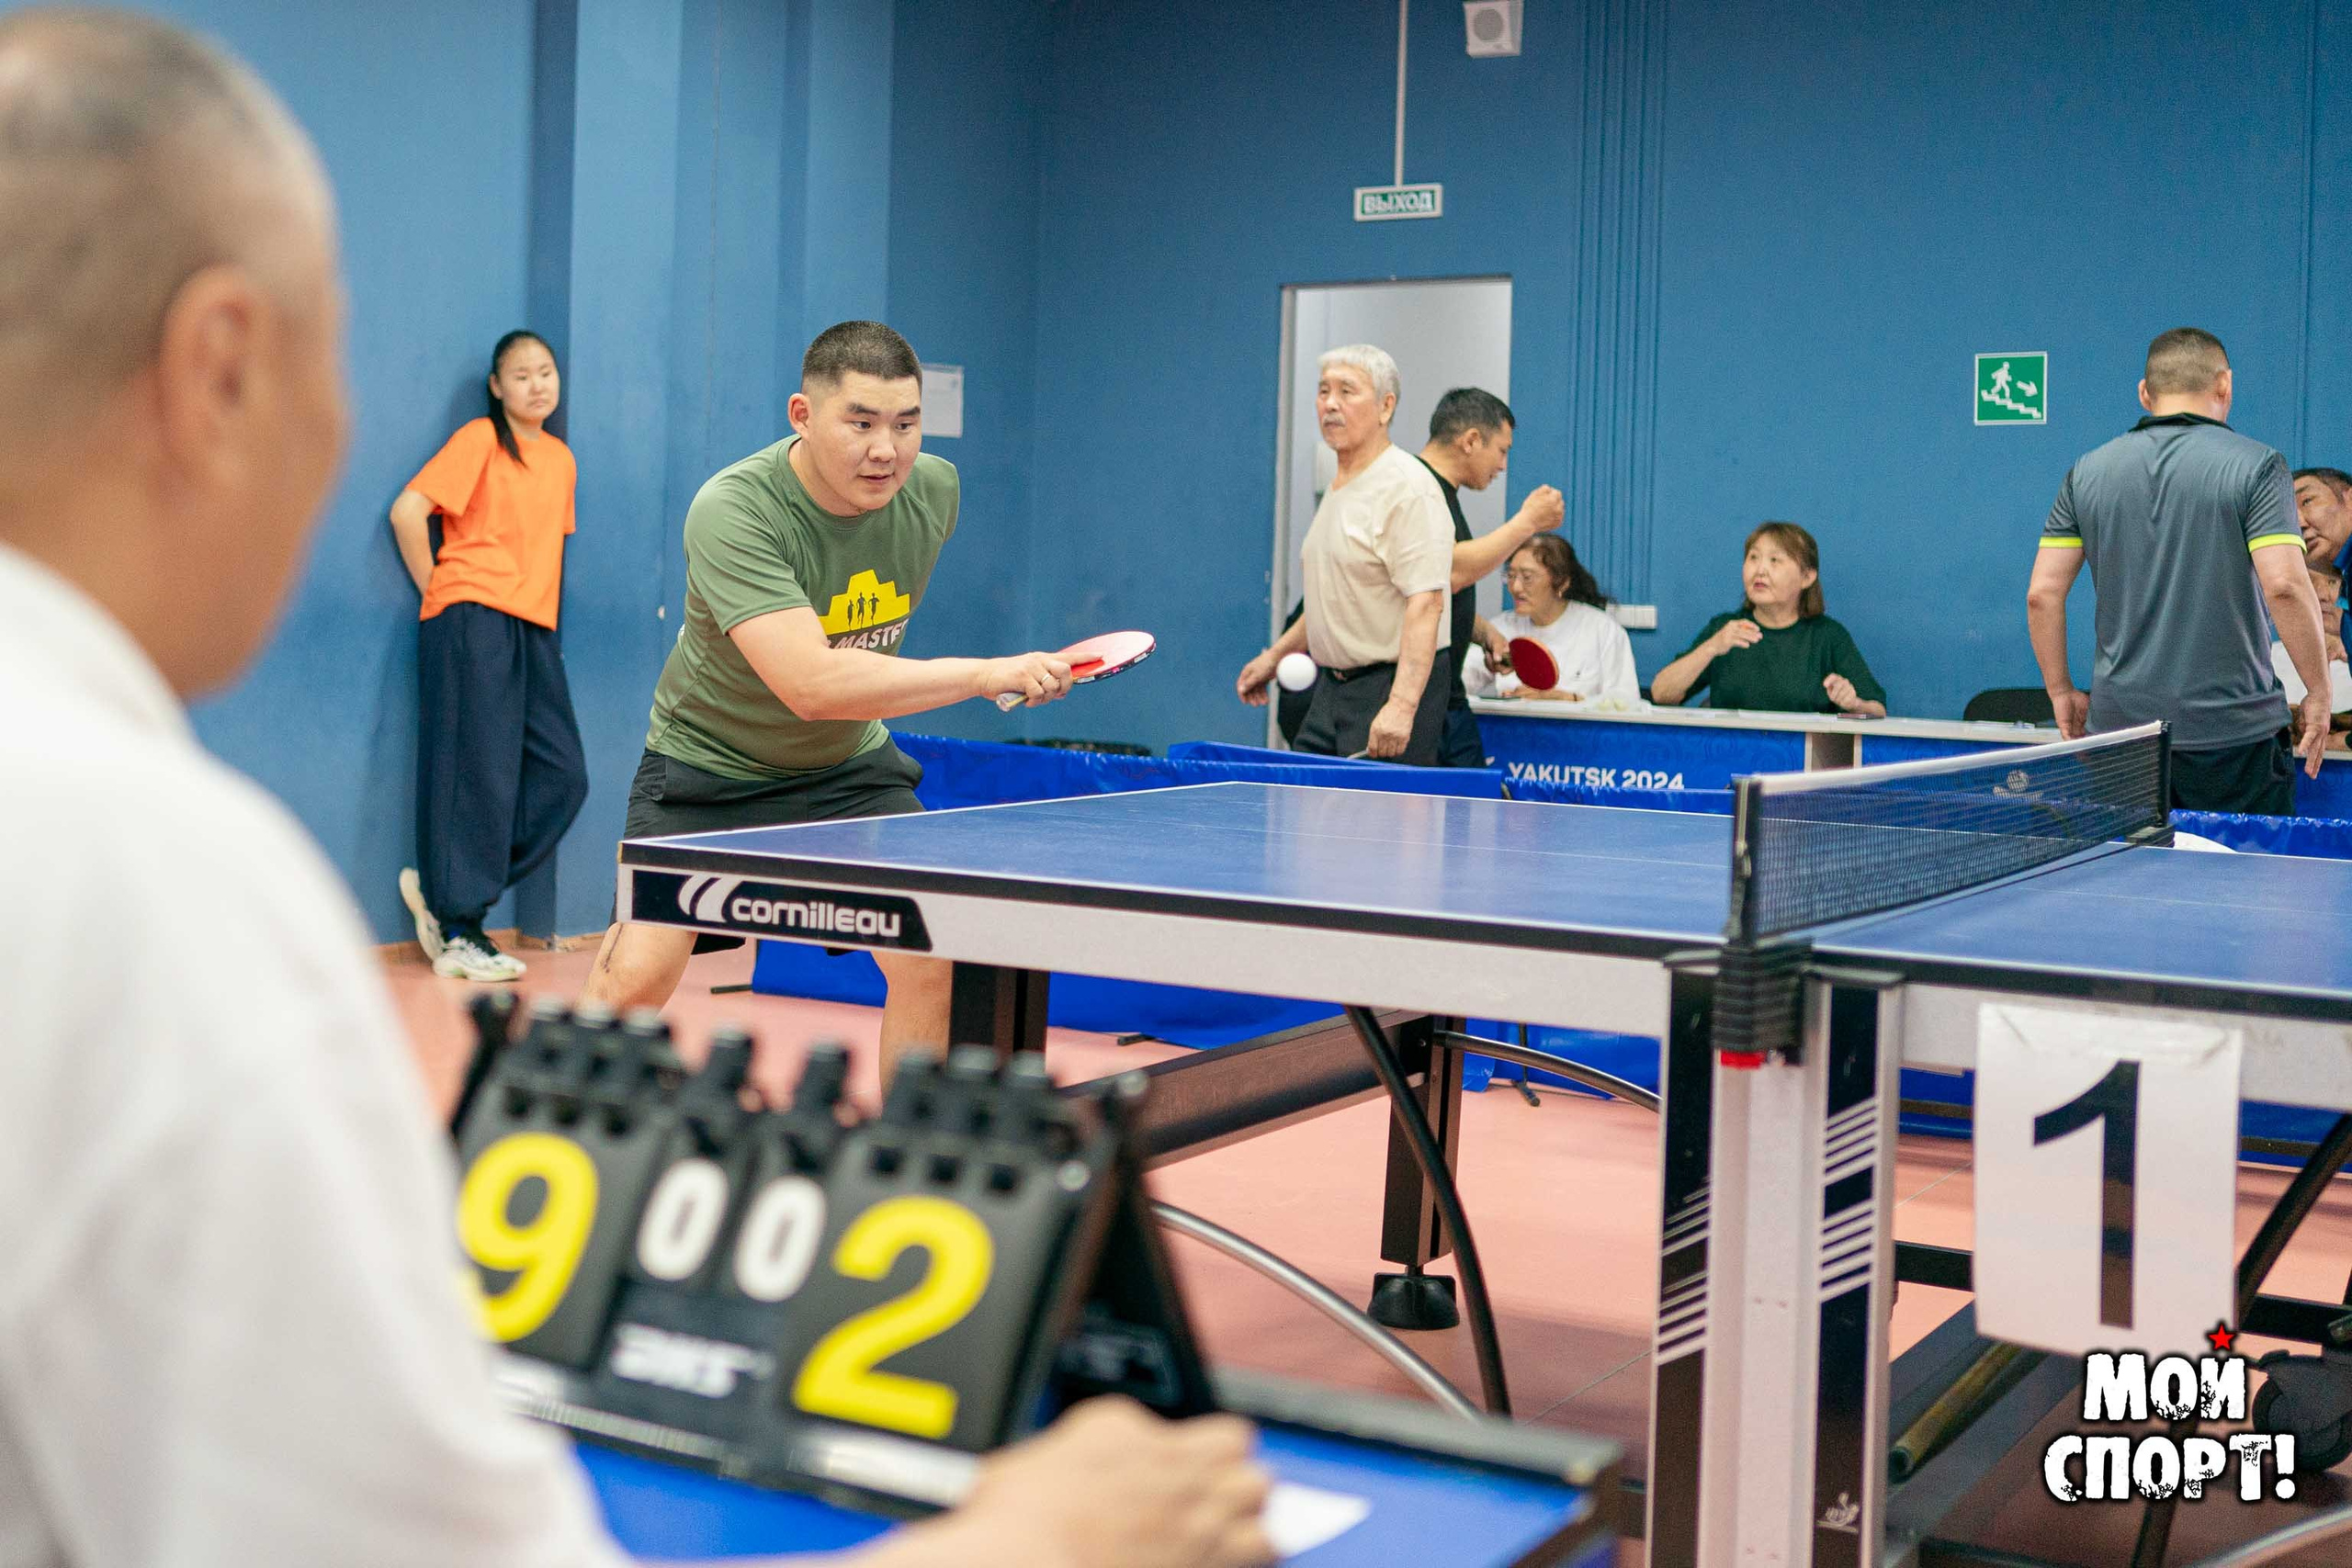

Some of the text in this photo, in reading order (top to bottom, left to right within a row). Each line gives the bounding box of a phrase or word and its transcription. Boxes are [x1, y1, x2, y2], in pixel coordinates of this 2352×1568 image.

[1364, 193, 1432, 213] ВЫХОД
[1508, 761, 1684, 790] YAKUTSK 2024
[731, 897, 901, 938] cornilleau
[2032, 1059, 2142, 1330] 1
[459, 1133, 599, 1342] 9
[637, 1158, 729, 1281] 0
[733, 1175, 827, 1303] 0
[792, 1196, 994, 1439] 2
